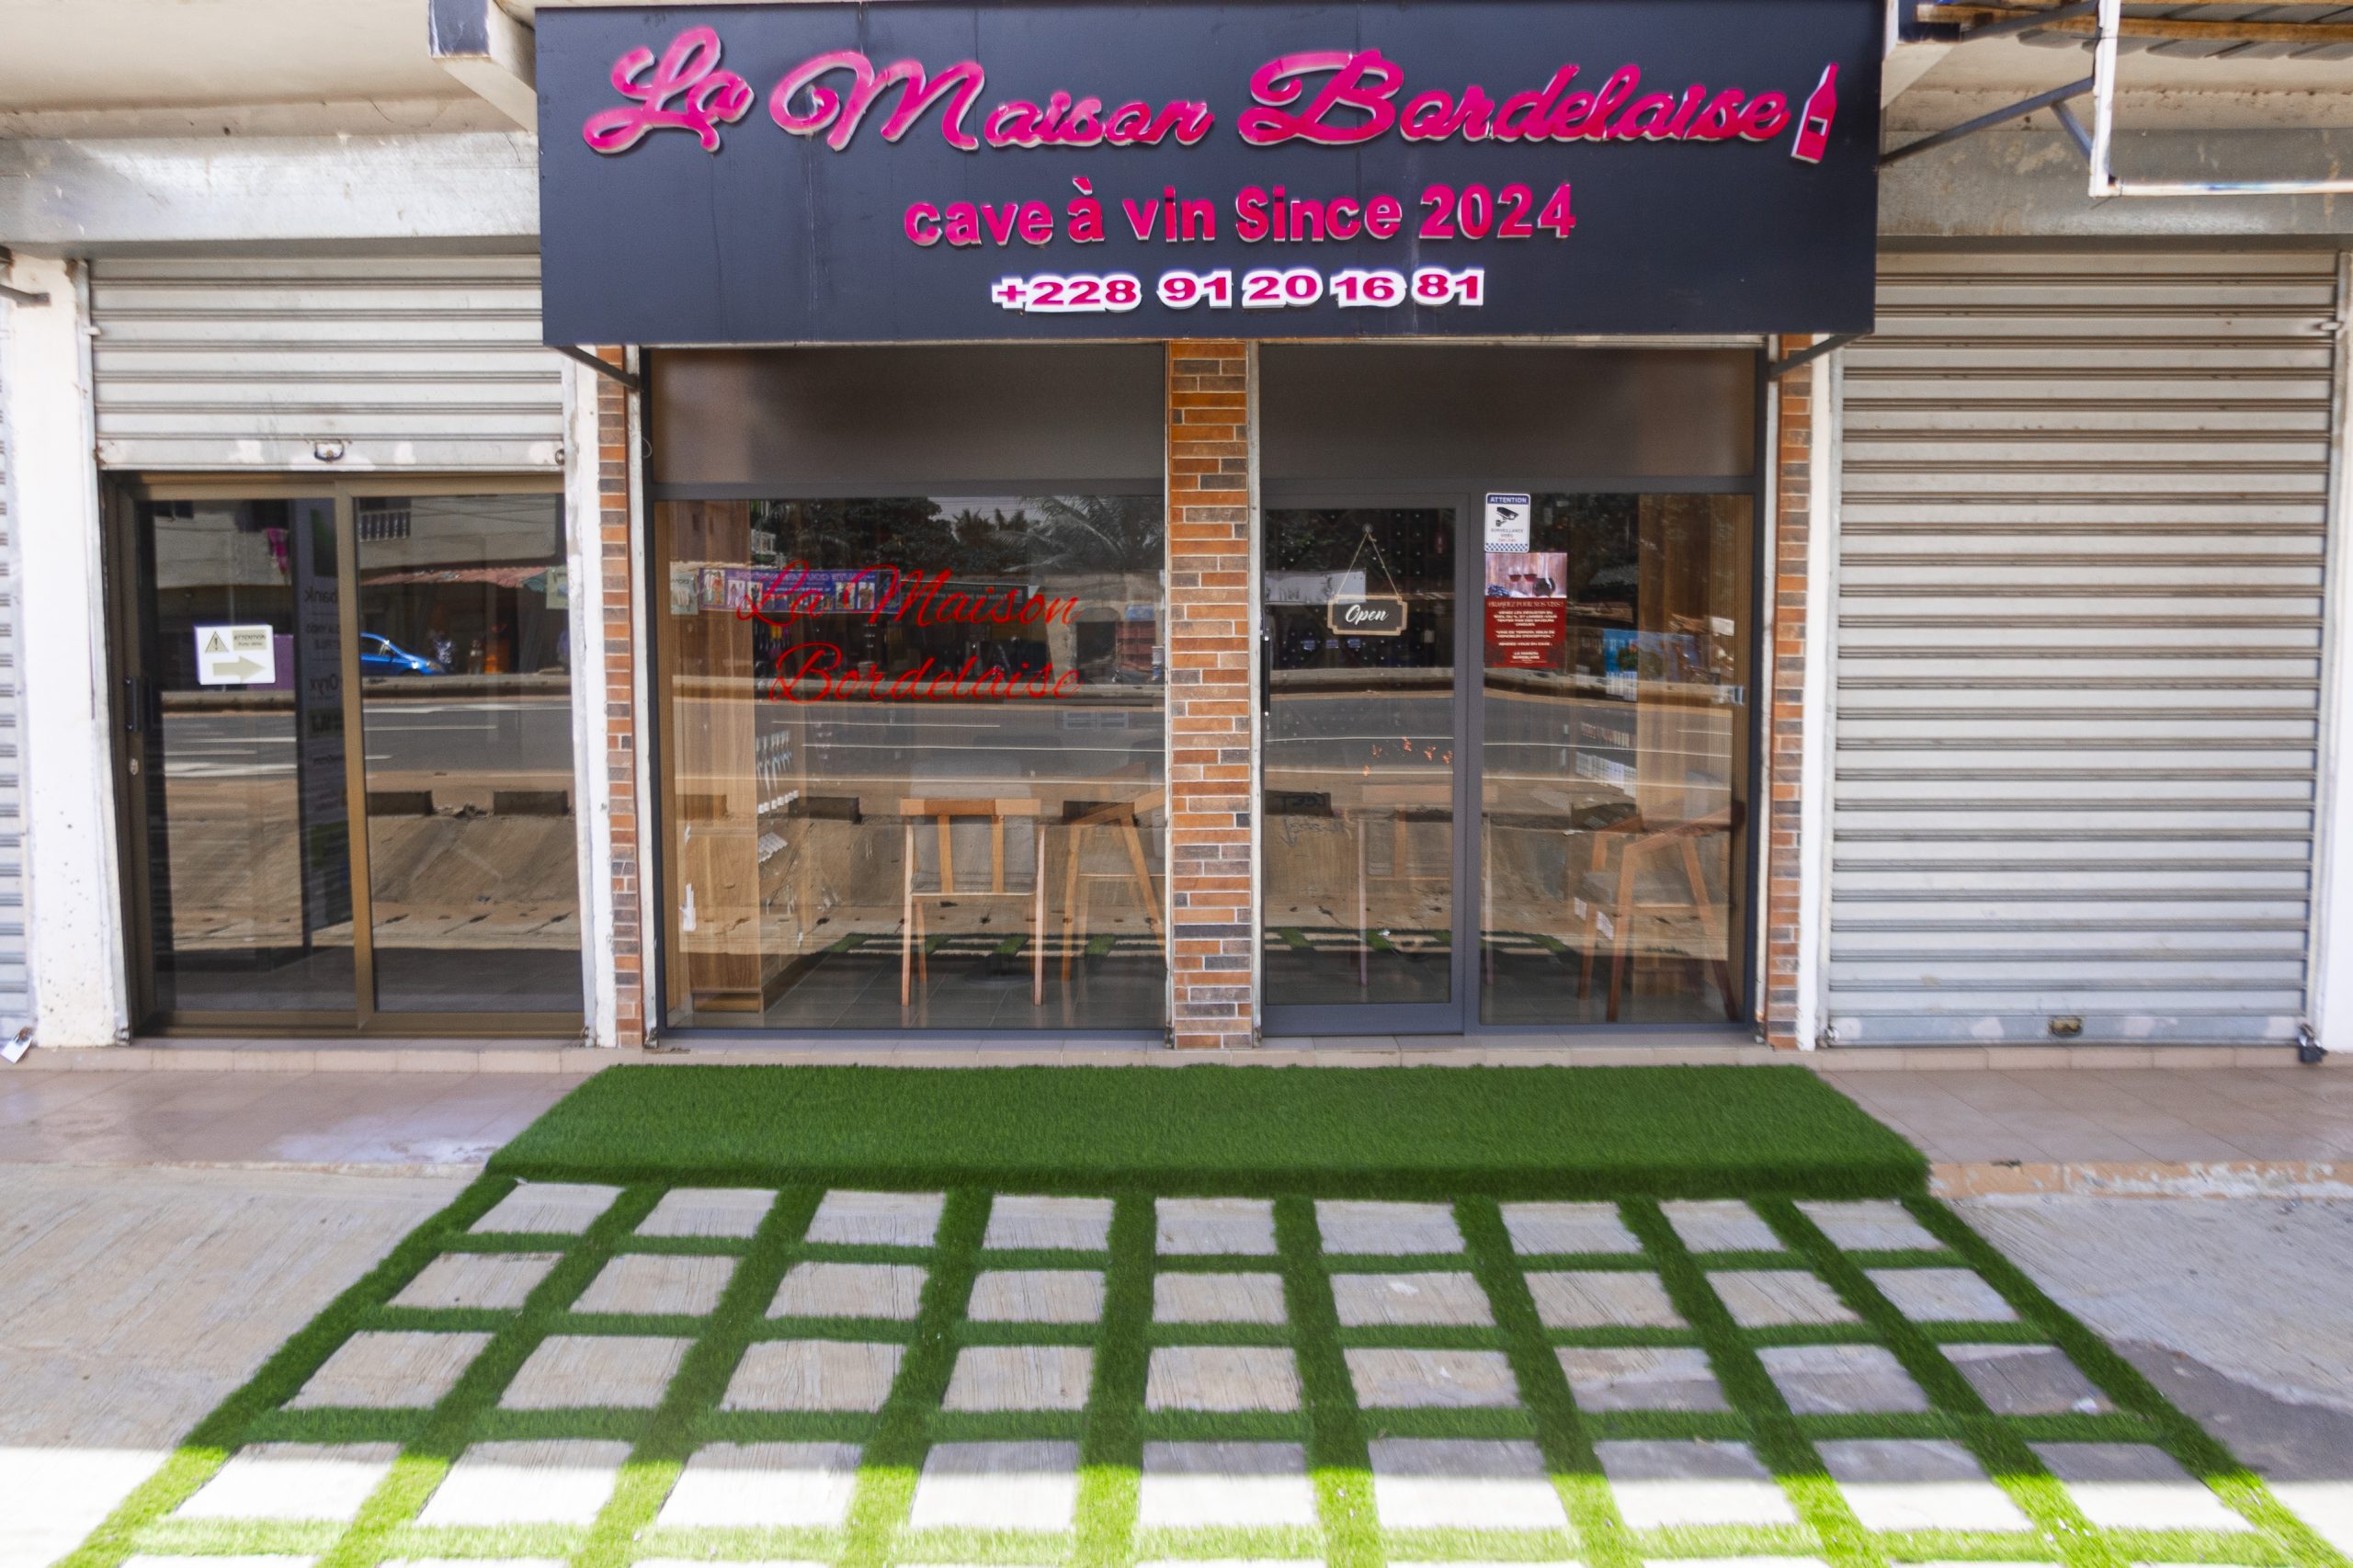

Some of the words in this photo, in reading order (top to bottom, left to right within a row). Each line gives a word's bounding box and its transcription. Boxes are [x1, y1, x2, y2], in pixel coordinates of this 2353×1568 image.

[583, 26, 754, 154] La
[769, 50, 1215, 152] Maison
[1238, 49, 1790, 145] Bordelaise
[904, 200, 1054, 246] cave
[1067, 176, 1105, 243] à
[1122, 186, 1216, 243] vin
[1236, 186, 1403, 242] Since
[1419, 183, 1576, 239] 2024
[993, 276, 1141, 311] +228
[1158, 272, 1232, 308] 91
[1243, 270, 1323, 307] 20
[1331, 271, 1405, 307] 16
[1412, 268, 1484, 306] 81
[735, 559, 825, 628] La
[846, 563, 1083, 628] Maison
[1345, 604, 1390, 625] Open
[769, 642, 1086, 704] Bordelaise
